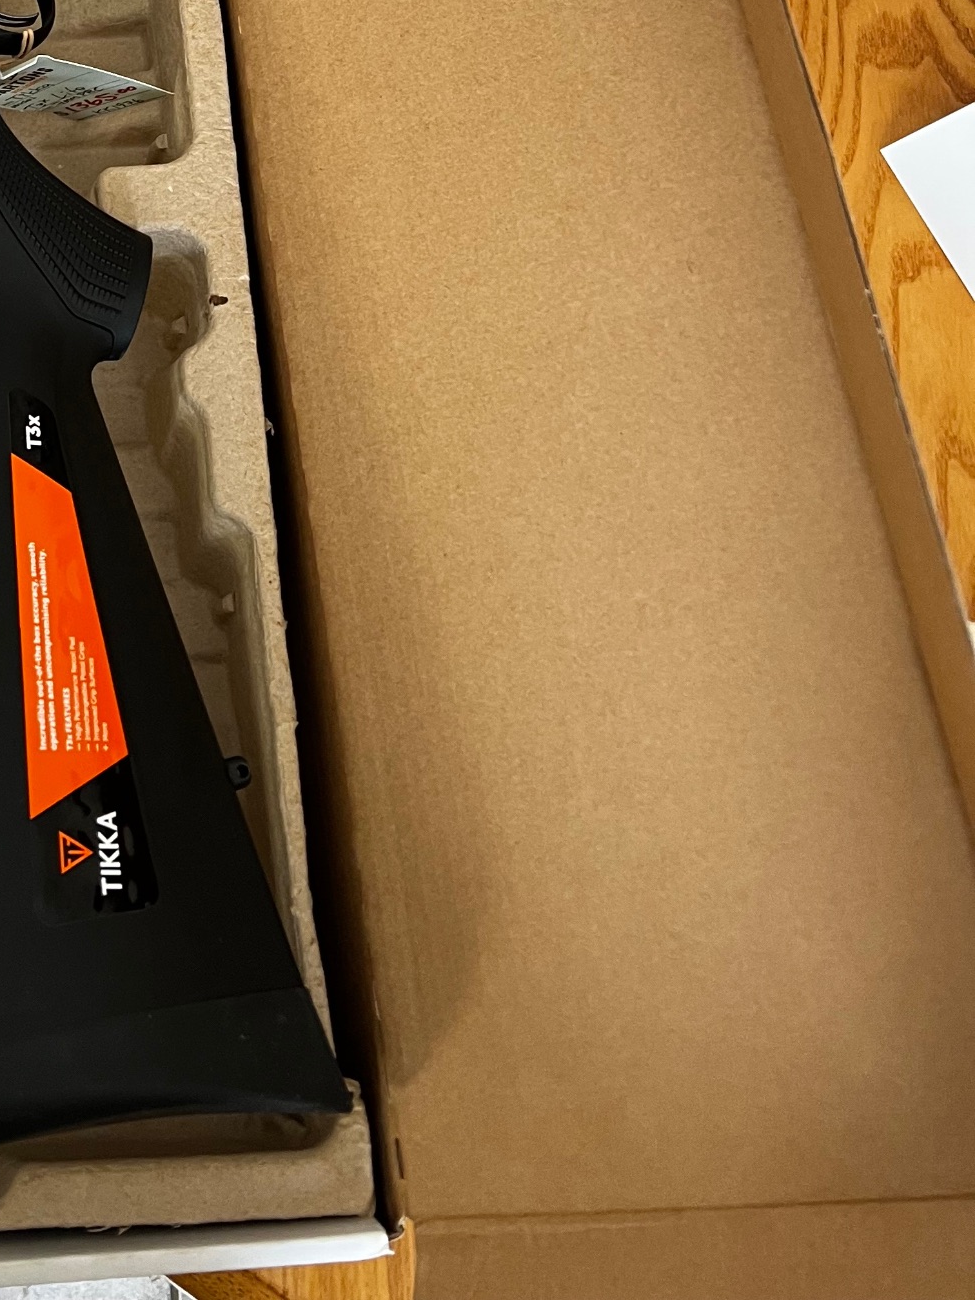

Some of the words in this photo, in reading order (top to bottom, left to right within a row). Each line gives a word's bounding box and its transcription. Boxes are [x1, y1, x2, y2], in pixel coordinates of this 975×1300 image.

[25, 414, 42, 450] T3x
[28, 542, 37, 577] smooth
[39, 548, 48, 596] reliability.
[31, 579, 40, 624] accuracy,
[33, 625, 41, 644] box
[41, 597, 53, 679] uncompromising
[34, 645, 44, 698] out-of-the
[46, 680, 54, 700] and
[62, 687, 72, 733] FEATURES
[72, 674, 81, 721] Performance
[81, 681, 92, 741] Interchangeable
[90, 688, 98, 705] Grip
[37, 698, 47, 751] Incredible
[48, 700, 59, 752] operation
[65, 733, 74, 752] T3x
[75, 721, 83, 741] High
[92, 705, 101, 742] Improved
[96, 811, 123, 896] TIKKA
